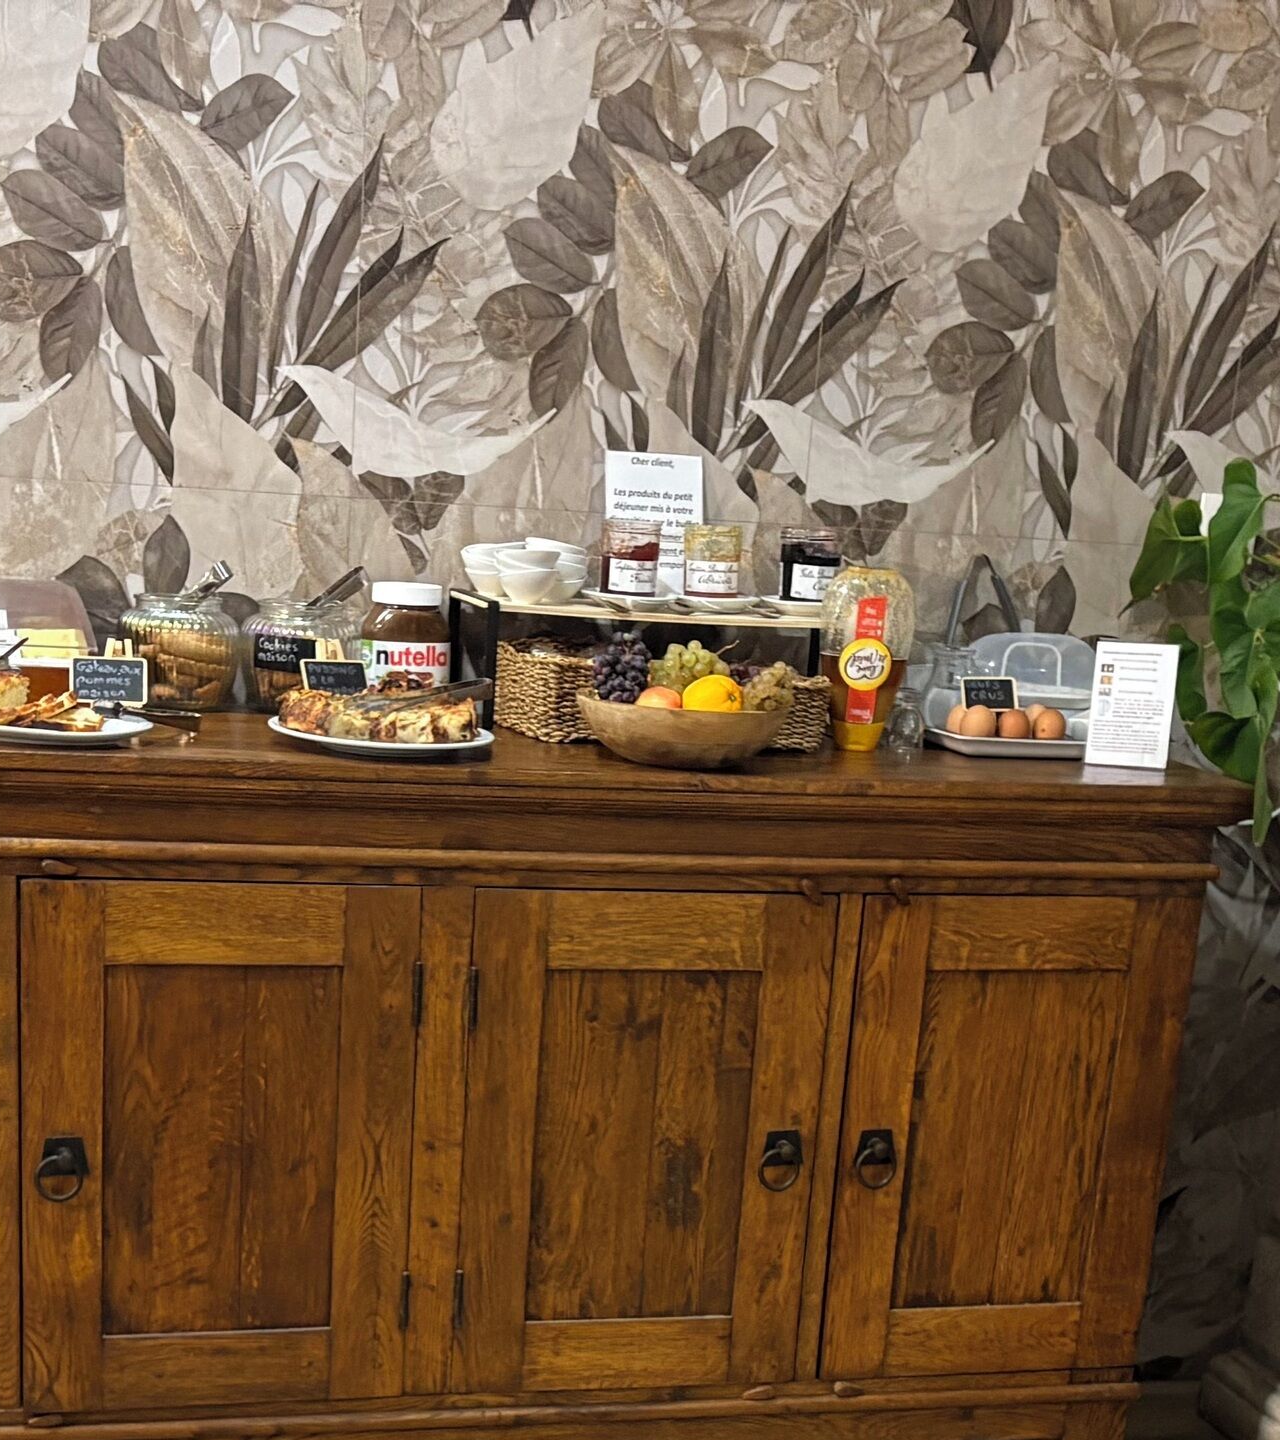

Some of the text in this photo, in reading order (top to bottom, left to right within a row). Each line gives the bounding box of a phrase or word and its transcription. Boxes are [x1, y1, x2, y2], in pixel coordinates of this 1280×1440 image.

[631, 456, 649, 466] Cher
[613, 487, 693, 502] Les produits du petit
[613, 501, 649, 512] déjeuner
[650, 503, 664, 513] mis
[672, 507, 694, 515] votre
[258, 636, 299, 652] Cookies
[375, 645, 448, 667] nutella
[970, 690, 1005, 701] CRUS
